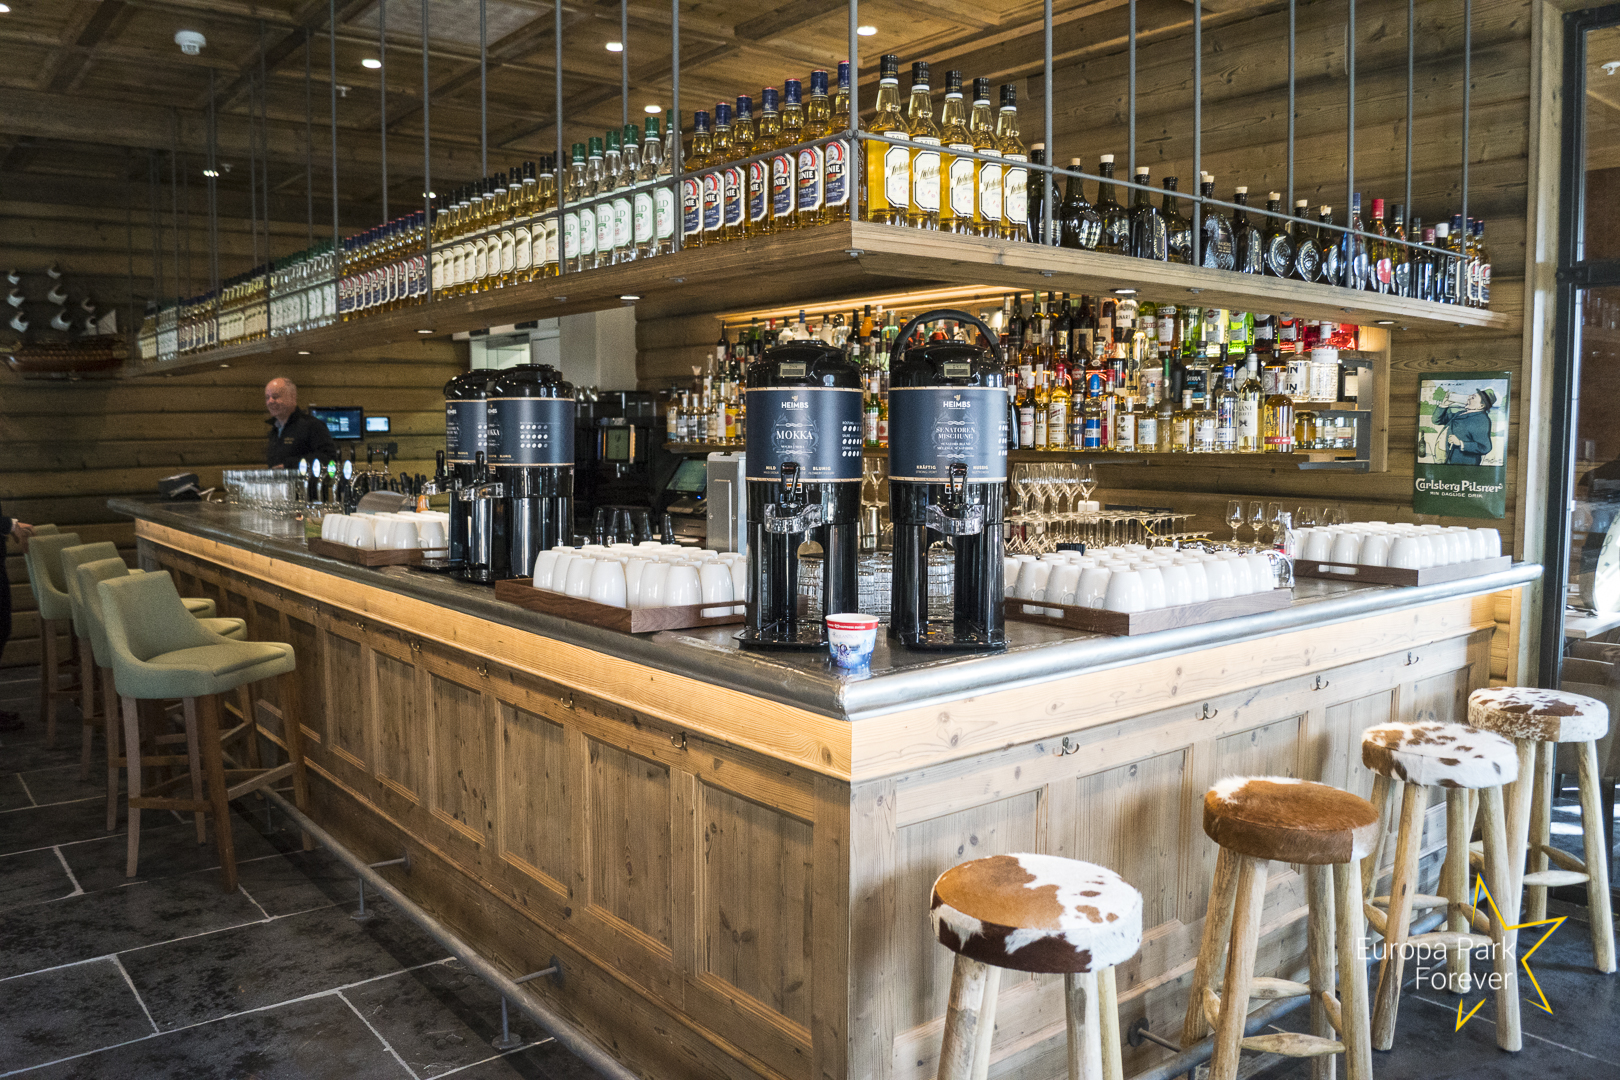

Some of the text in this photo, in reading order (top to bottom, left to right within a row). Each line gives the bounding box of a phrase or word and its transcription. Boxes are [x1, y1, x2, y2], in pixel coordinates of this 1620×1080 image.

[776, 430, 813, 440] MOKKA
[1415, 478, 1503, 493] Carlsberg Pilsner
